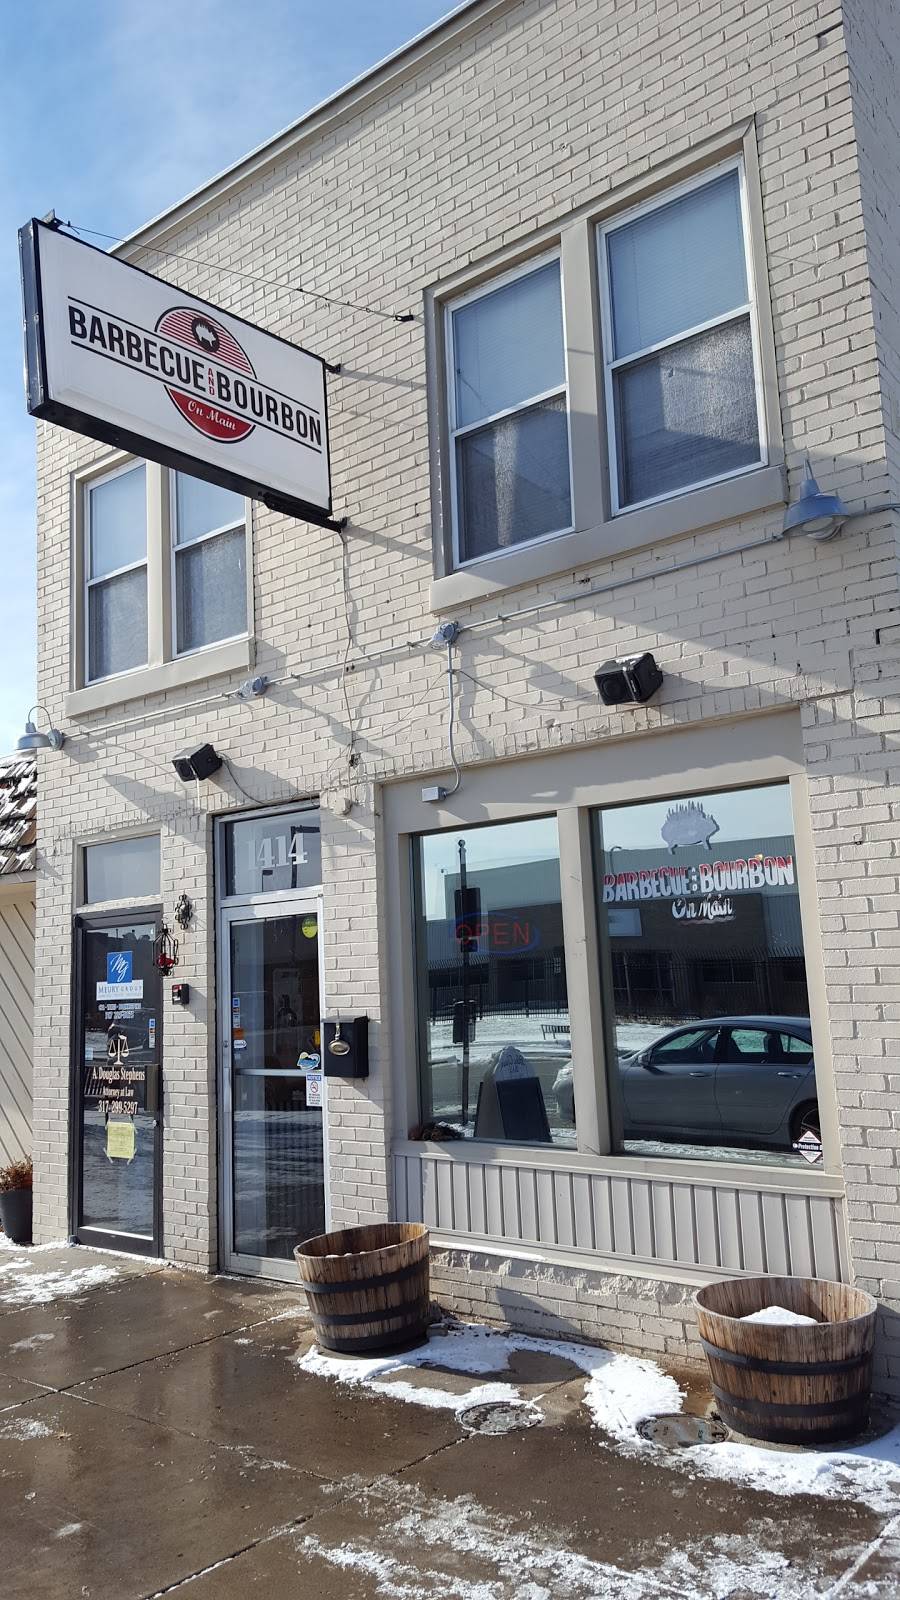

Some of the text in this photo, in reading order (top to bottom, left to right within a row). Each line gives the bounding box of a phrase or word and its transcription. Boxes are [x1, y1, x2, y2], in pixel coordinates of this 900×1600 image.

[68, 305, 322, 446] BARBECUE AND BOURBON
[187, 399, 237, 431] On Main
[247, 832, 309, 870] 1414
[602, 865, 691, 903] BARBECUE
[698, 855, 795, 893] BOURBON
[671, 893, 735, 920] On Main
[455, 921, 530, 946] OPEN
[98, 1066, 121, 1084] Douglas
[120, 1067, 146, 1084] Stephens
[125, 1086, 134, 1097] Law
